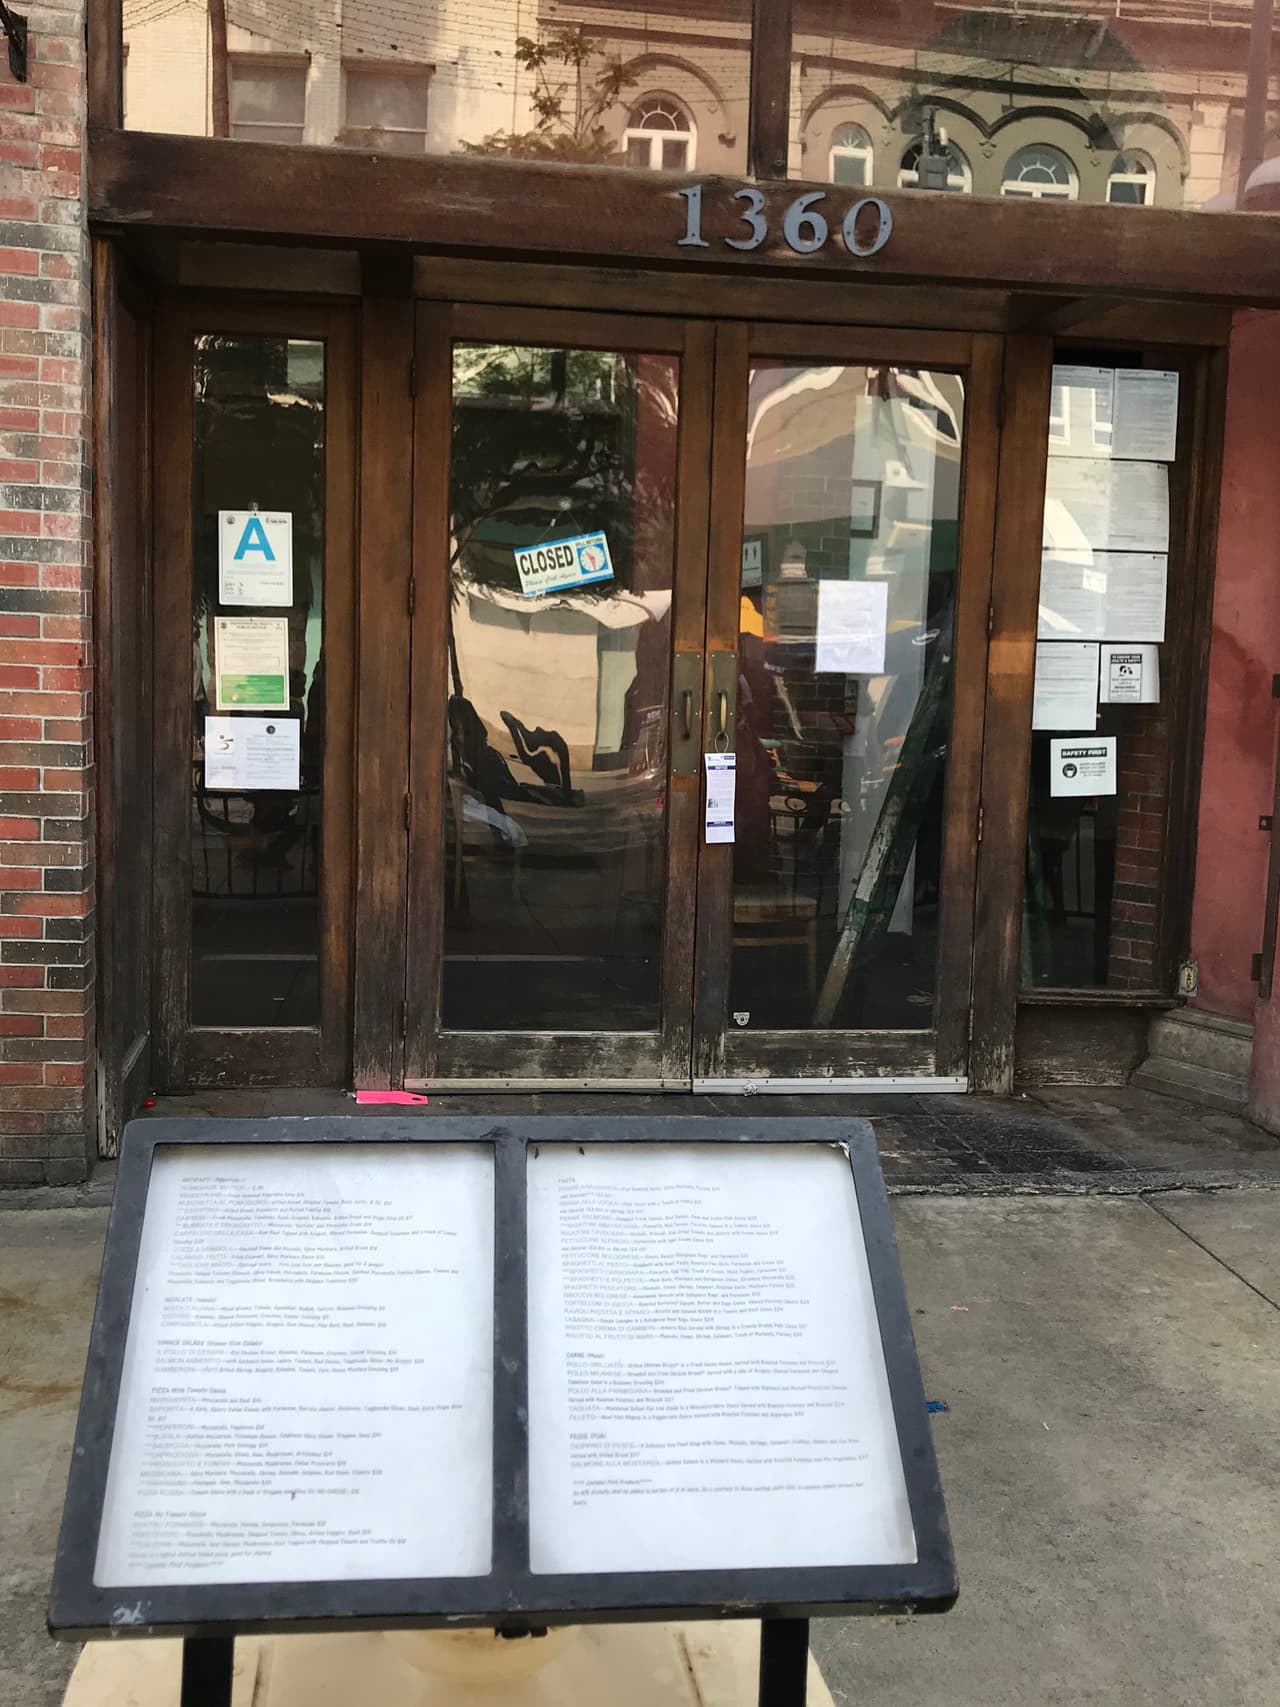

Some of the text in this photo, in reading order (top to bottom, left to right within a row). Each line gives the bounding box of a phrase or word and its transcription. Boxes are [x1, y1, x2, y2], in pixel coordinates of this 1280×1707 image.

[676, 184, 893, 257] 1360
[233, 517, 276, 561] A
[520, 545, 574, 576] CLOSED
